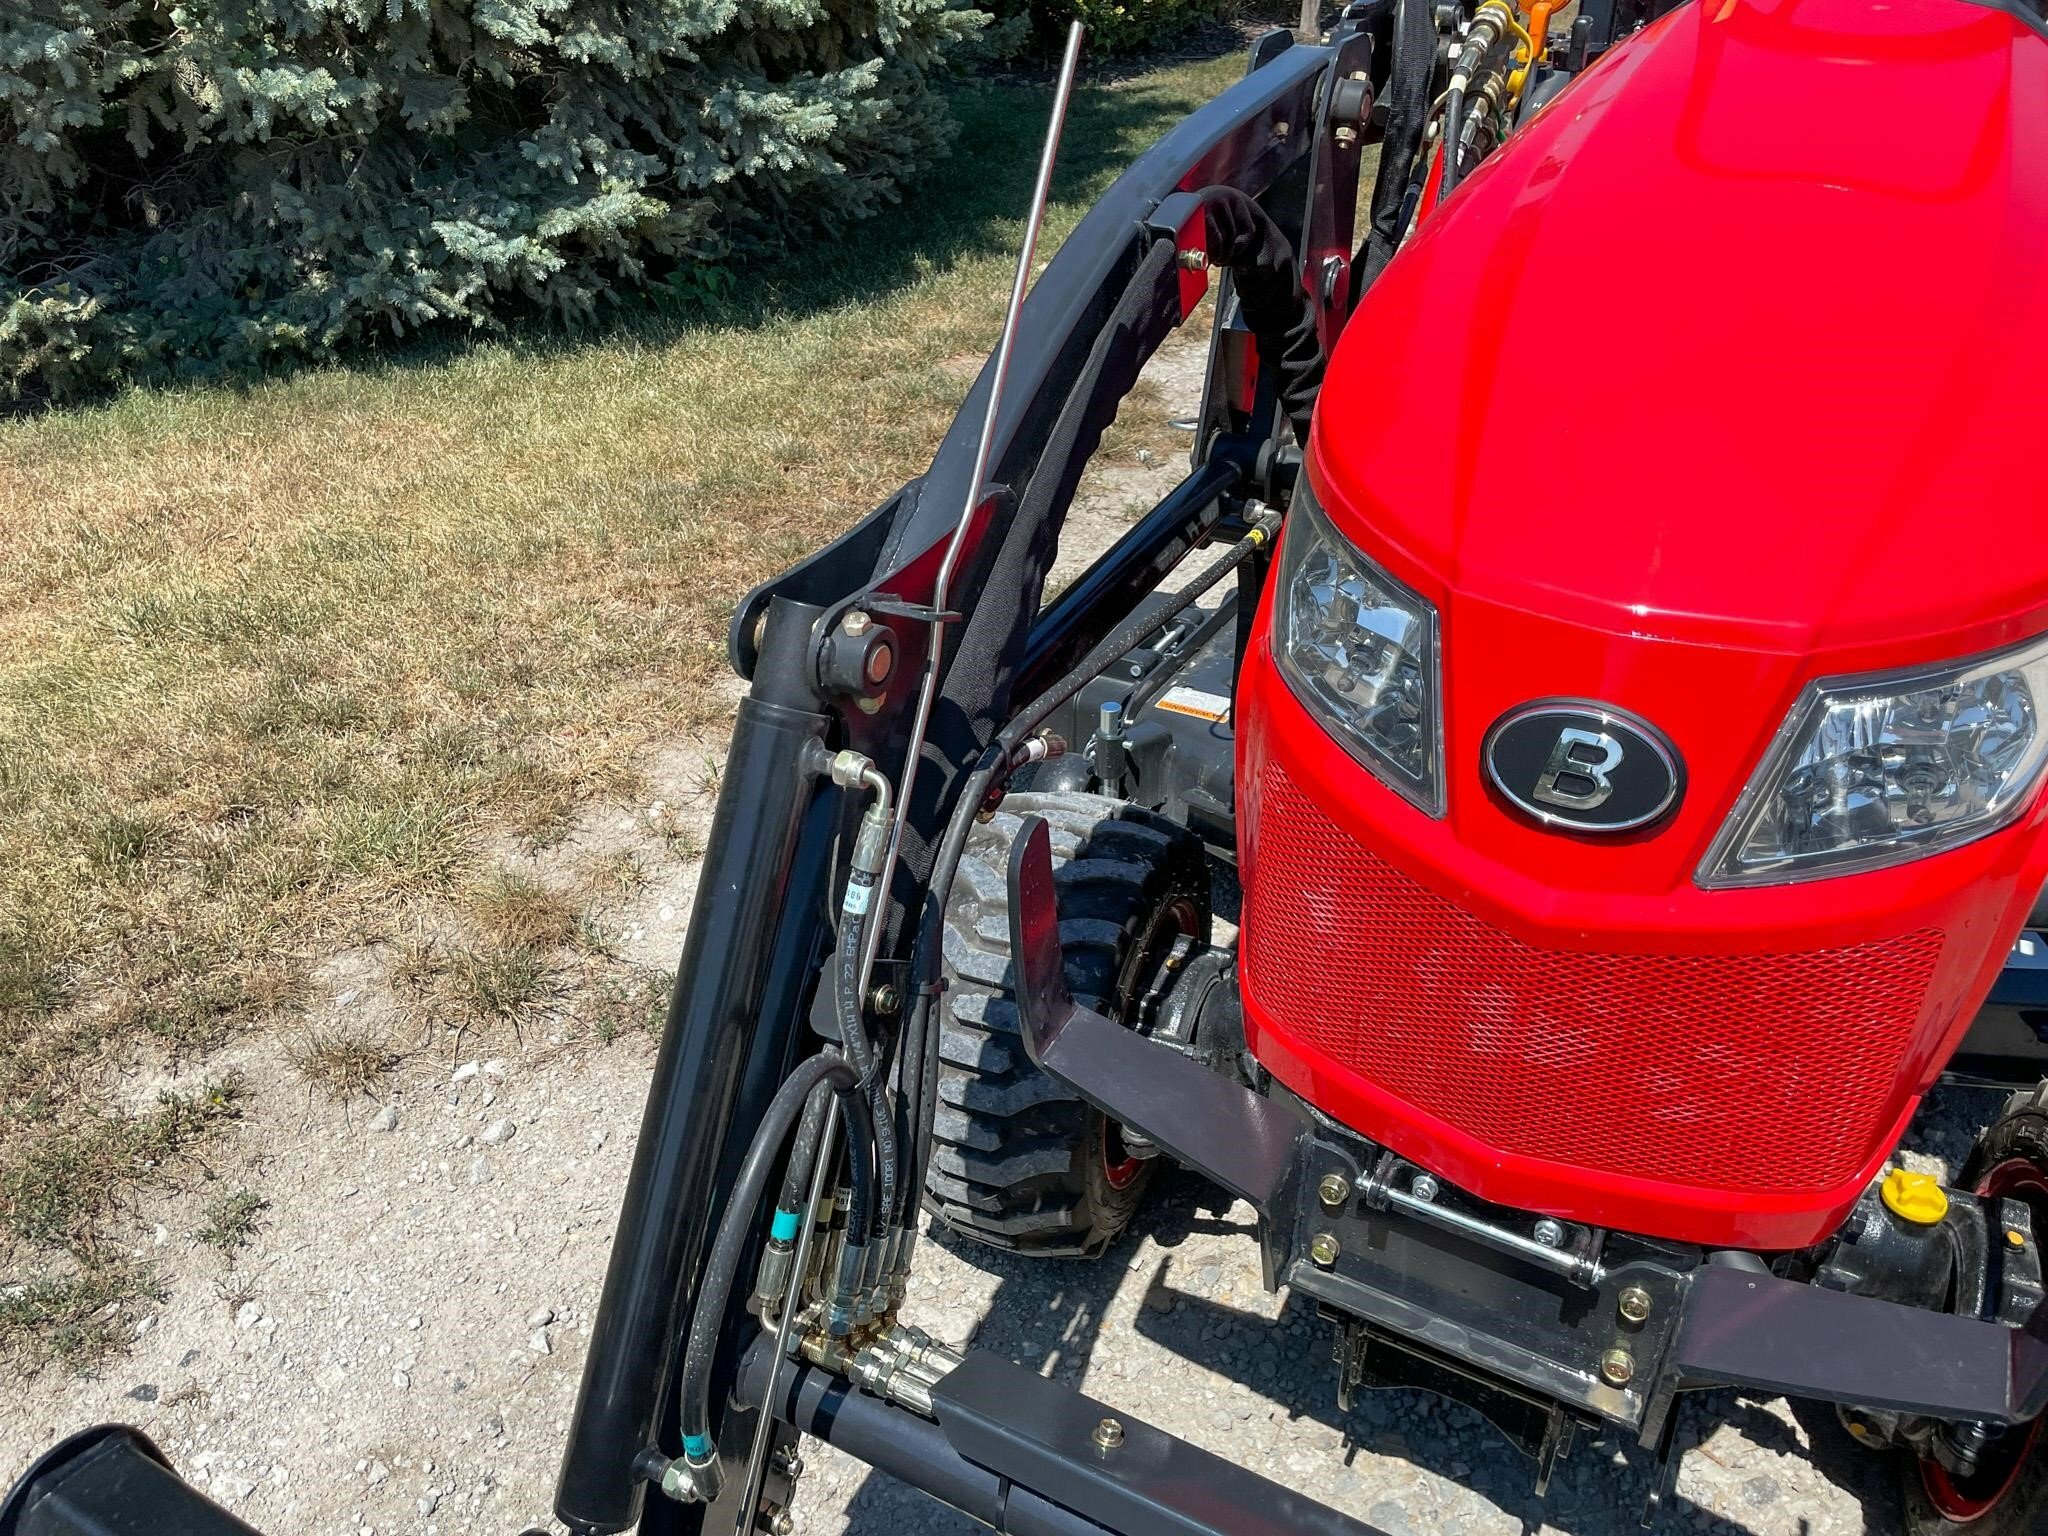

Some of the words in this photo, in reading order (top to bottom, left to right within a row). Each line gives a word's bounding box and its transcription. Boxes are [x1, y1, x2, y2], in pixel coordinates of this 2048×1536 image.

[1532, 727, 1624, 811] B
[875, 1107, 891, 1137] SKIVE
[881, 1193, 892, 1214] SAE
